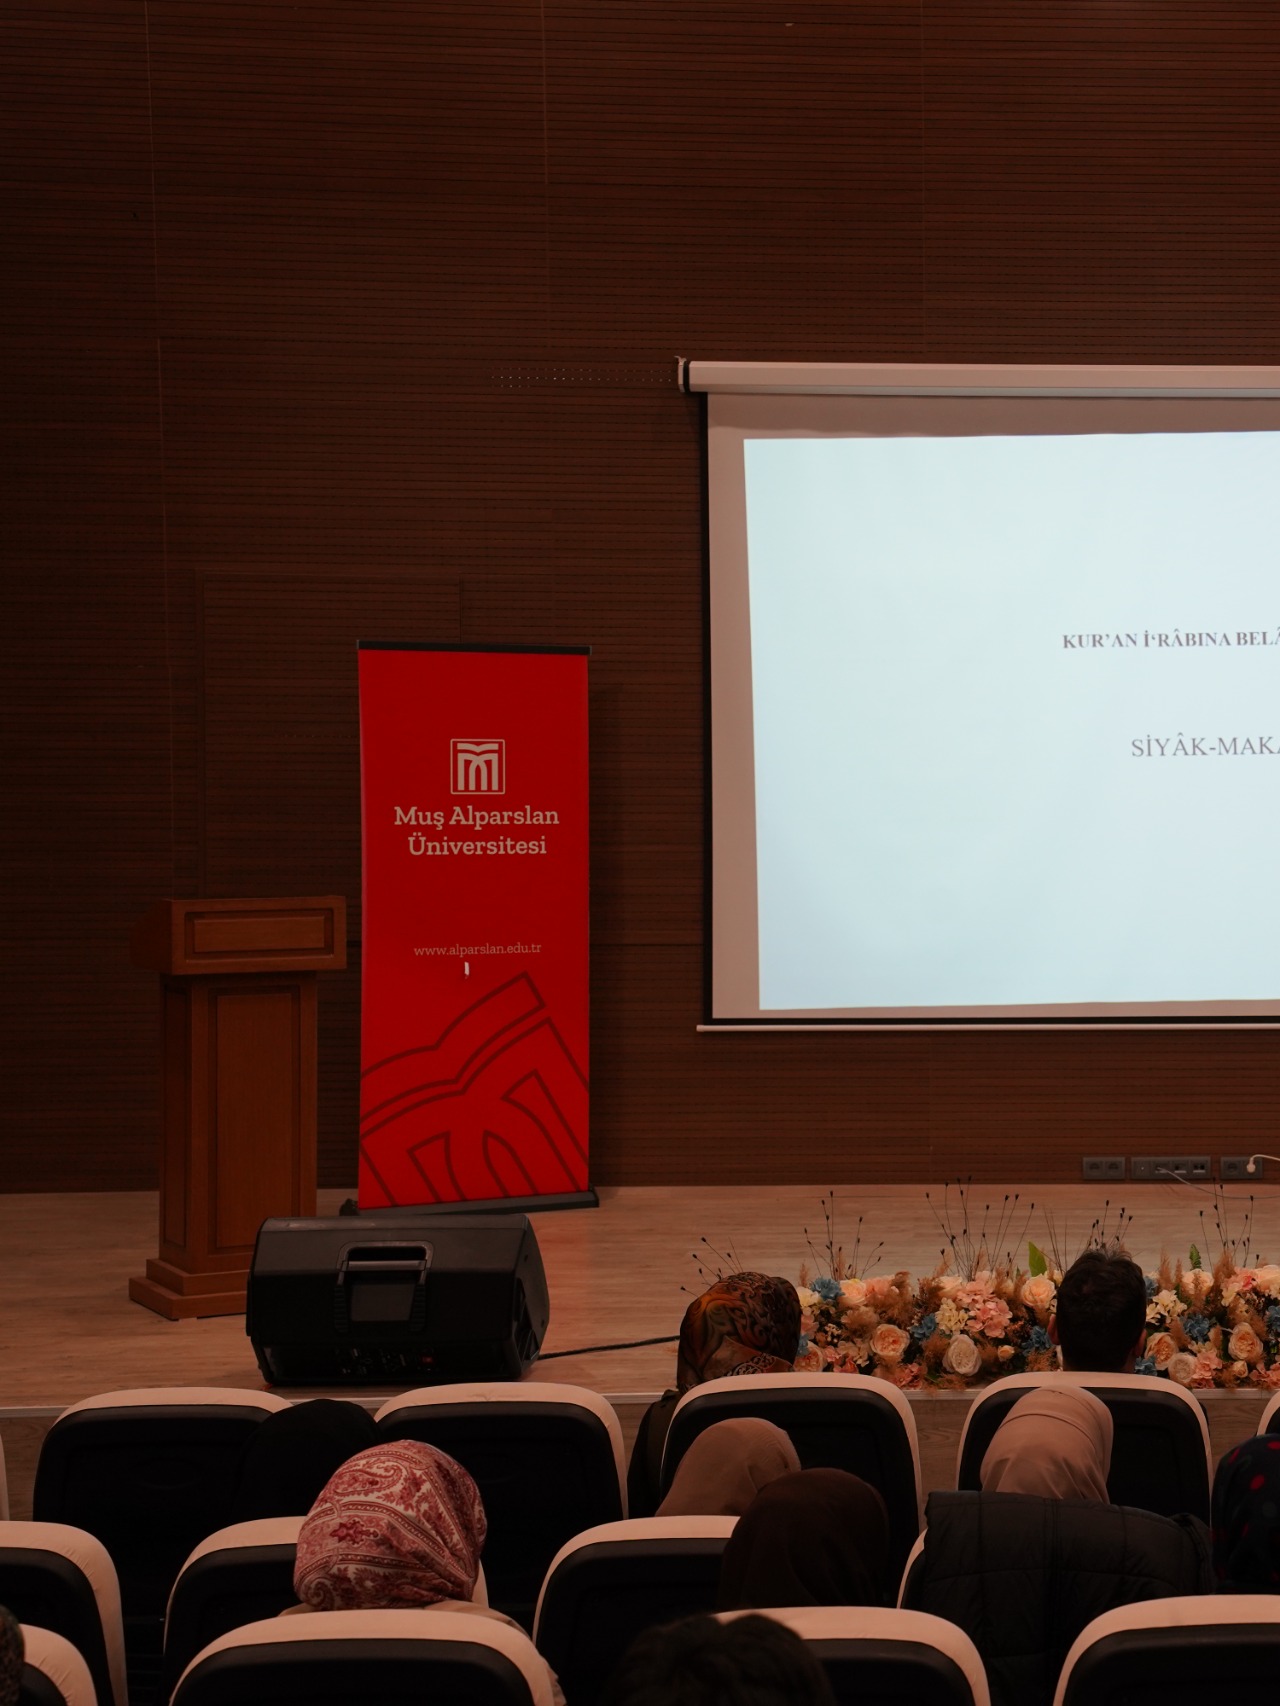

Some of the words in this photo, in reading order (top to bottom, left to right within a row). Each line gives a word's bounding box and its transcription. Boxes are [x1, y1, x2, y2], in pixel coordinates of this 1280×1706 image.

[1062, 633, 1138, 648] KUR’AN
[394, 806, 445, 829] Muş
[449, 805, 560, 830] Alparslan
[408, 832, 547, 855] Üniversitesi
[413, 942, 542, 957] www.alparslan.edu.tr
